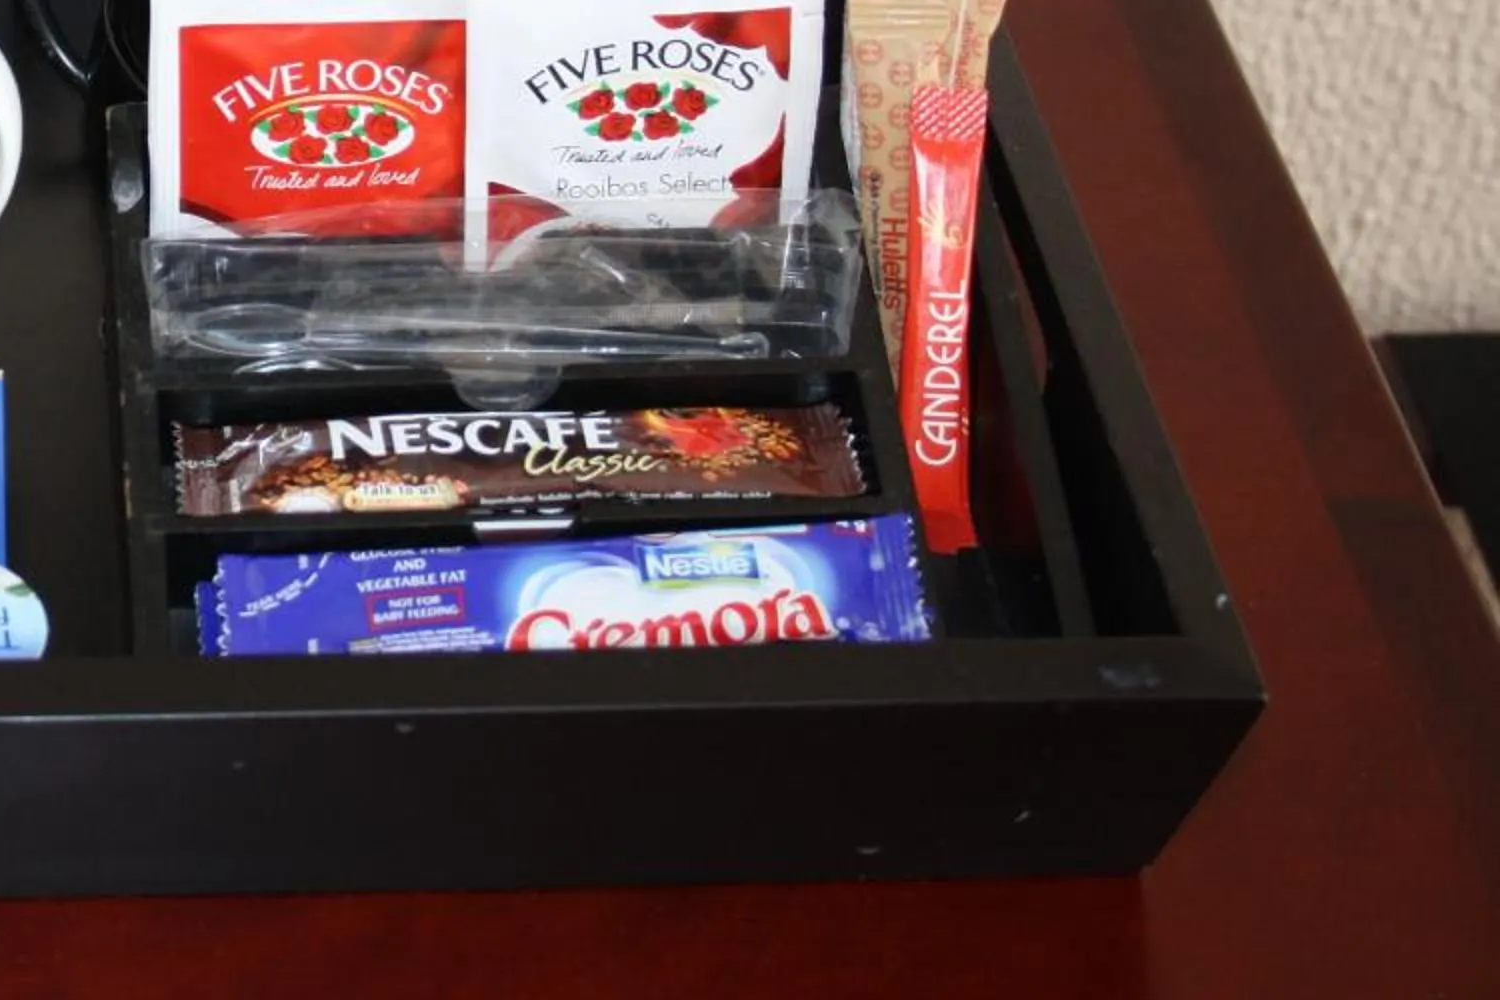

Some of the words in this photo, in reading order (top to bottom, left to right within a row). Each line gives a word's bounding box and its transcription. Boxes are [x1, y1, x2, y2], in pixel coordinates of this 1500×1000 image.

[524, 43, 621, 105] FIVE
[631, 39, 759, 91] ROSES
[213, 62, 311, 122] FIVE
[318, 59, 449, 115] ROSES
[551, 144, 625, 164] Trusted
[630, 147, 669, 162] and
[672, 139, 723, 160] loved
[244, 165, 317, 190] Trusted
[324, 170, 364, 187] and
[367, 163, 420, 186] loved
[556, 175, 648, 200] Rooibos
[659, 172, 727, 195] Select
[914, 279, 967, 466] CANDEREL
[524, 441, 660, 481] Classic
[361, 484, 392, 497] Talk
[393, 558, 427, 572] AND
[356, 573, 437, 593] VEGETABLE
[440, 570, 467, 584] FAT
[388, 597, 413, 608] NOT
[416, 595, 441, 607] FOR
[373, 609, 405, 624] BABY
[508, 588, 834, 650] Cremora
